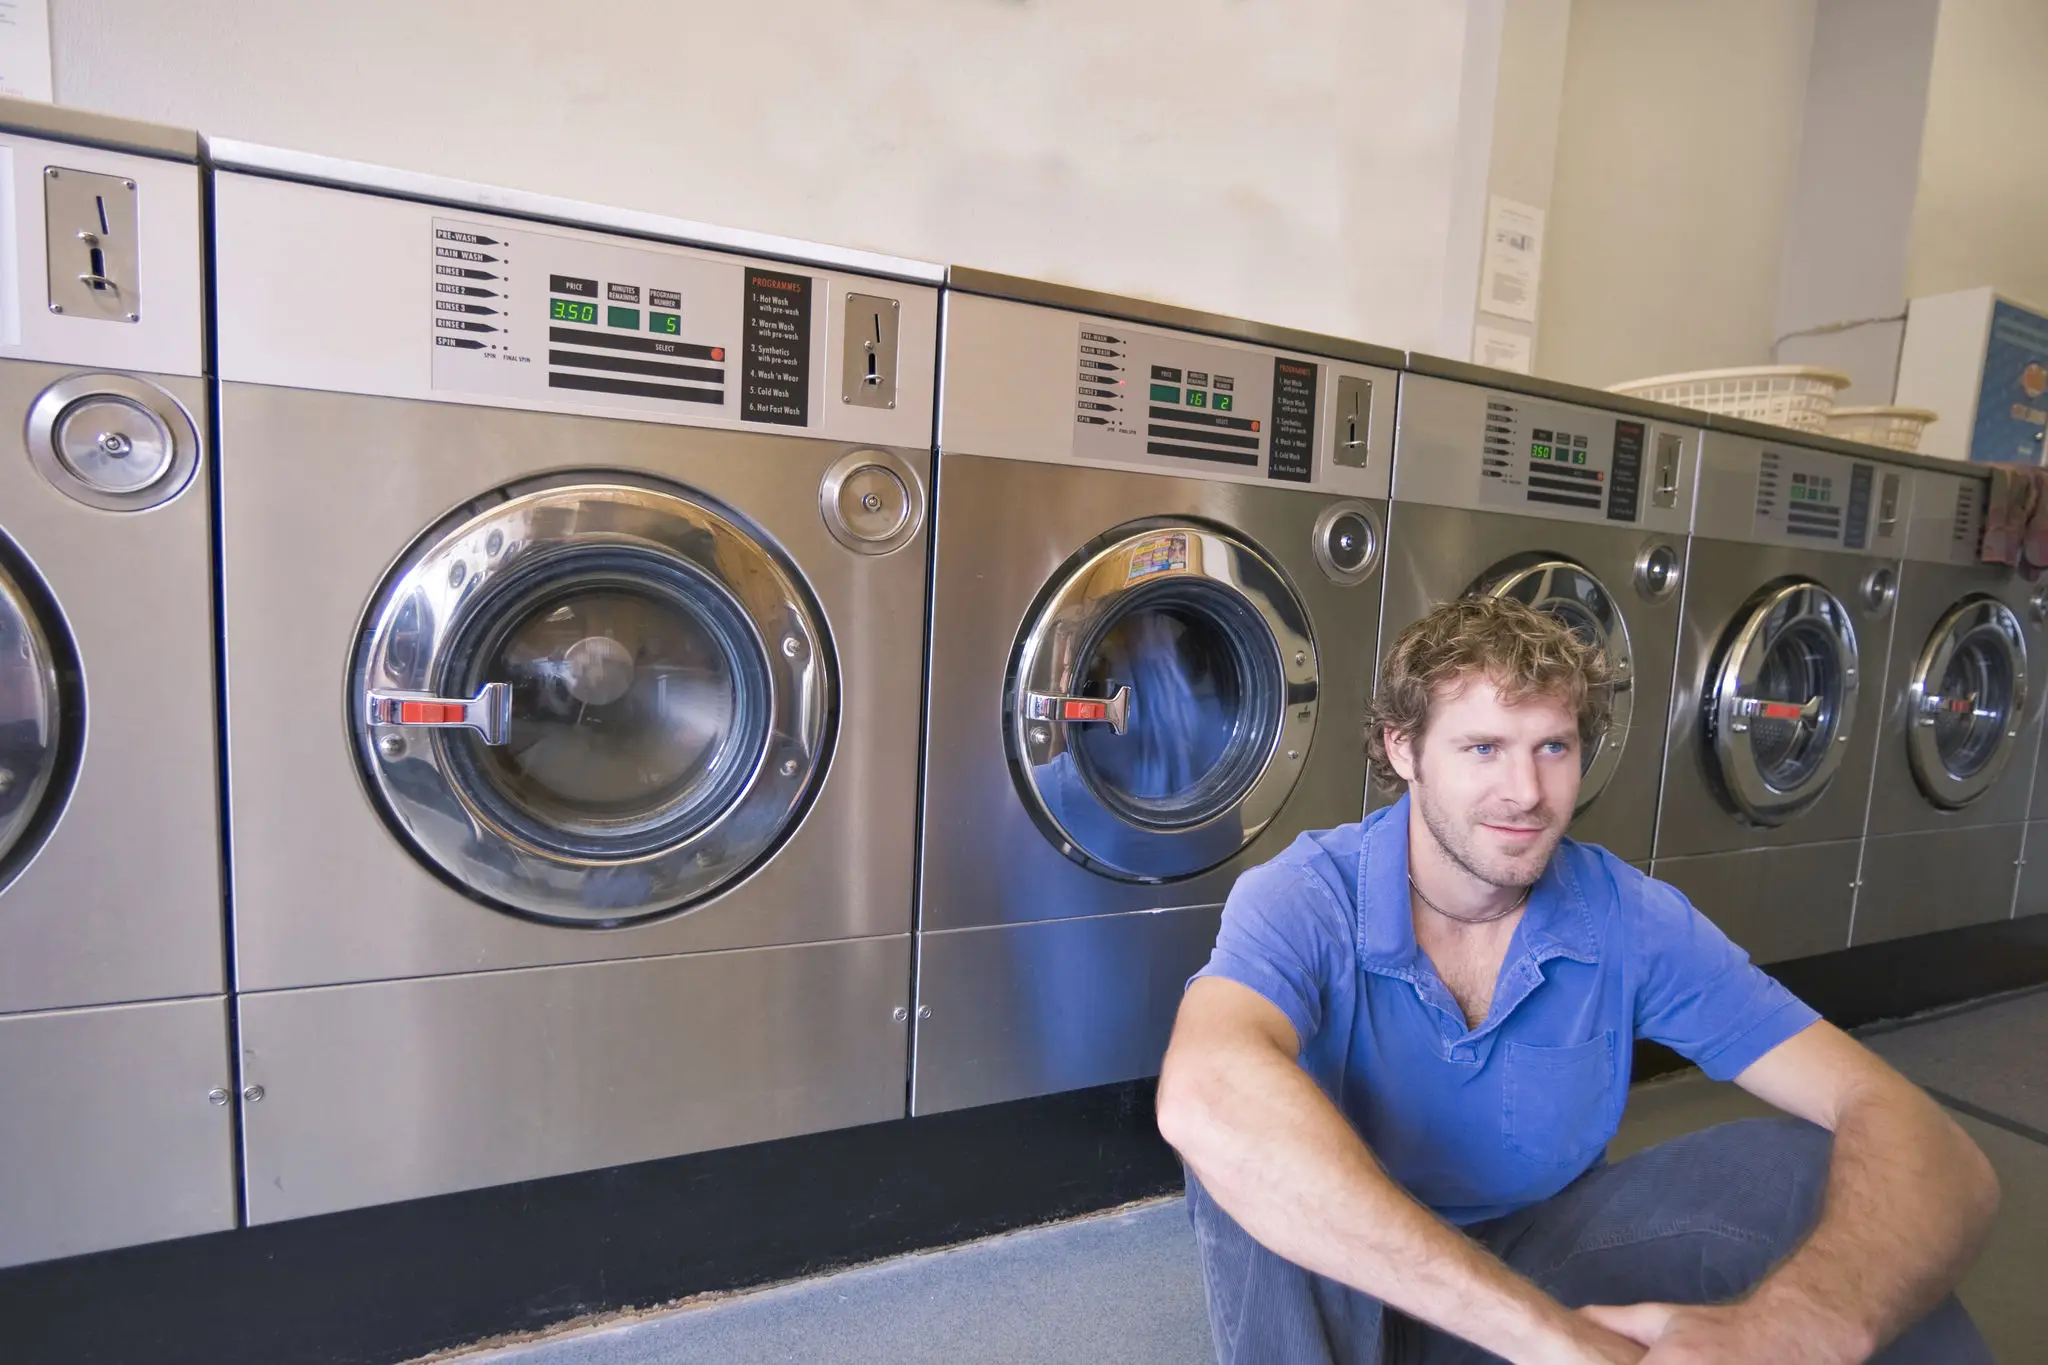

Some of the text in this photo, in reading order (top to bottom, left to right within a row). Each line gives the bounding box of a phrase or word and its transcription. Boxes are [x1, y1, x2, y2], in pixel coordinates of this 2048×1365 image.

[437, 230, 477, 243] PRE-WASH
[437, 248, 483, 261] MAIN WASH
[437, 265, 459, 276] RINSE
[437, 283, 459, 293] RINSE
[566, 282, 583, 291] PRICE
[611, 284, 635, 294] MINUTES
[752, 276, 801, 293] PROGRAMMES
[608, 292, 638, 302] REMAINING
[753, 293, 789, 306] 1. Hot Wash
[437, 301, 466, 312] RINSE 3
[654, 298, 676, 308] NUMBER
[554, 302, 594, 322] 3.50
[760, 304, 800, 316] with pre-wash
[437, 319, 459, 329] RINSE
[666, 317, 676, 332] 5
[752, 318, 794, 331] 2. Warm Wash
[759, 329, 798, 340] with pre-wash
[437, 337, 456, 346] SPIN
[655, 343, 675, 352] SELECT
[750, 344, 790, 356] 3. Synthetics
[503, 354, 518, 362] FINAL
[758, 354, 798, 366] with pre-wash
[750, 369, 756, 378] 4.
[758, 370, 774, 380] Wash
[782, 372, 799, 382] Wear
[750, 386, 790, 398] 5. Cold Wash
[1190, 394, 1202, 405] 16
[1221, 398, 1229, 409] 2
[749, 402, 800, 415] 6. Hot Fast Wash
